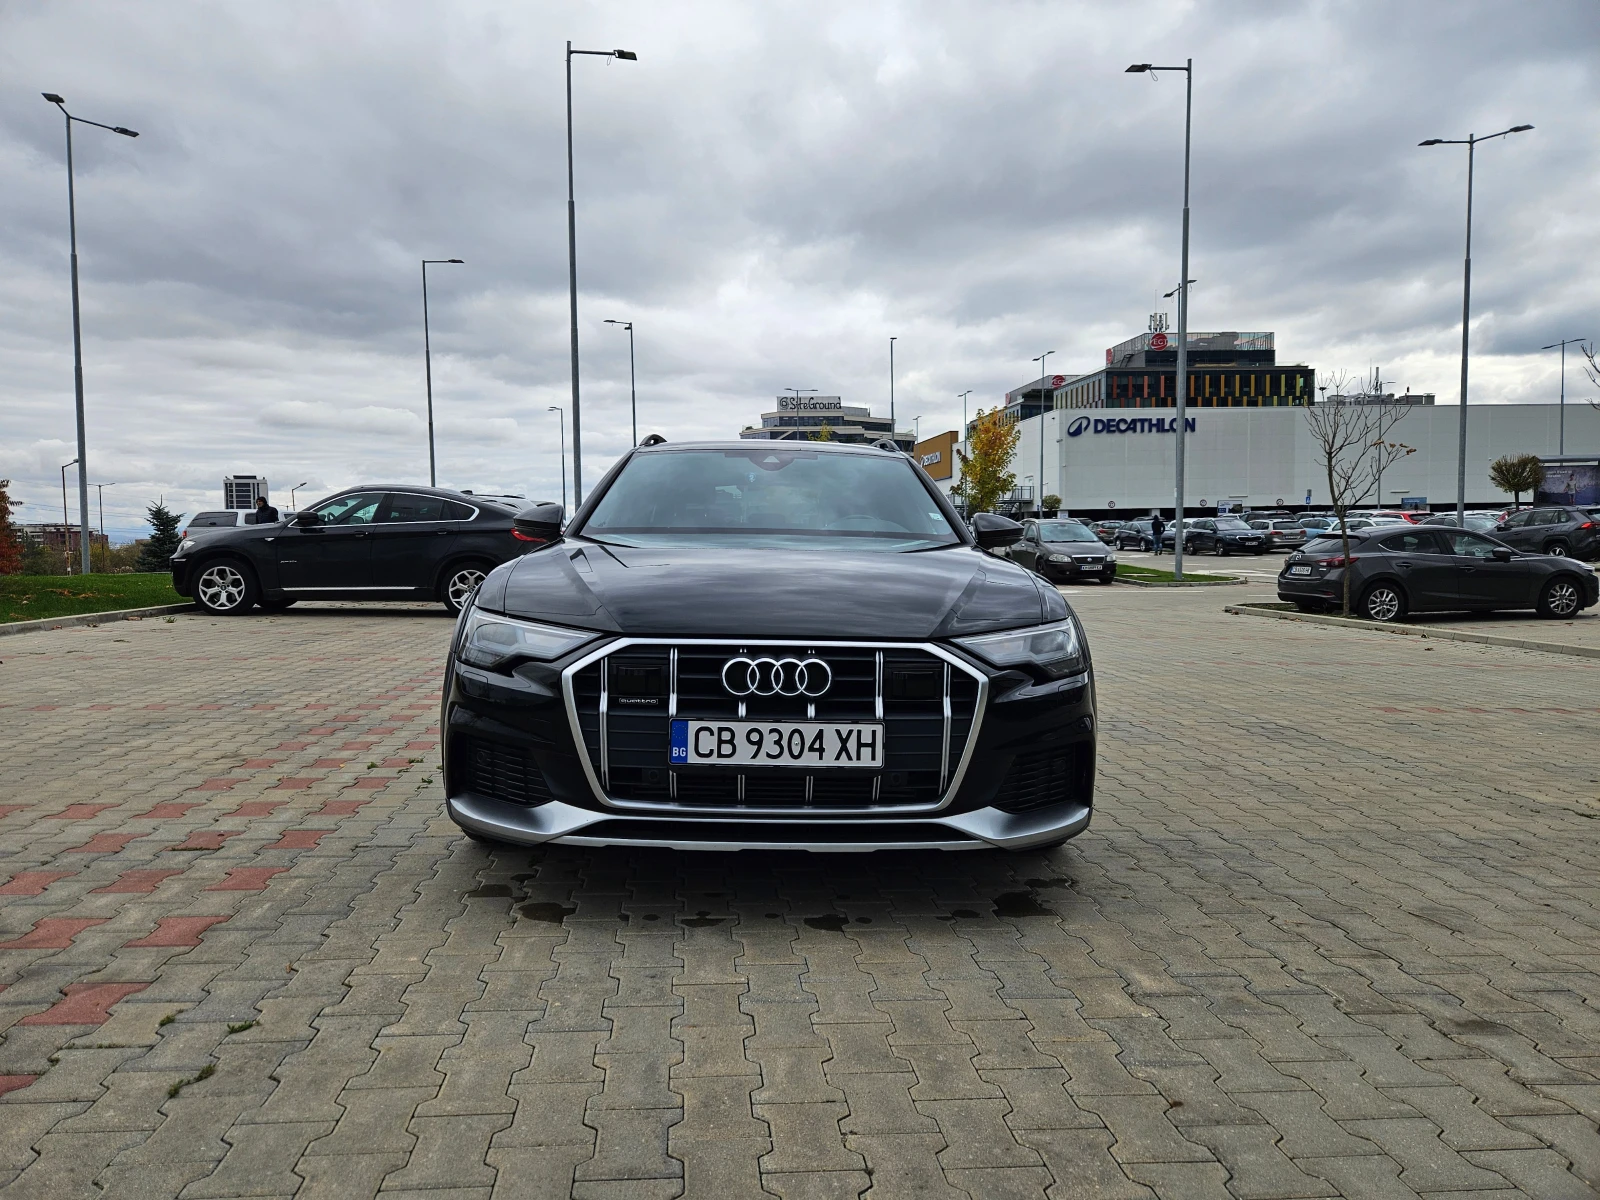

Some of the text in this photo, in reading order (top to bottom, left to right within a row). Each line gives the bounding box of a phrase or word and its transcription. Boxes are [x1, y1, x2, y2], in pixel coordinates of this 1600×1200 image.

[789, 397, 841, 410] SiteGround
[694, 726, 877, 761] CB 9304 XH
[672, 747, 687, 757] BG
